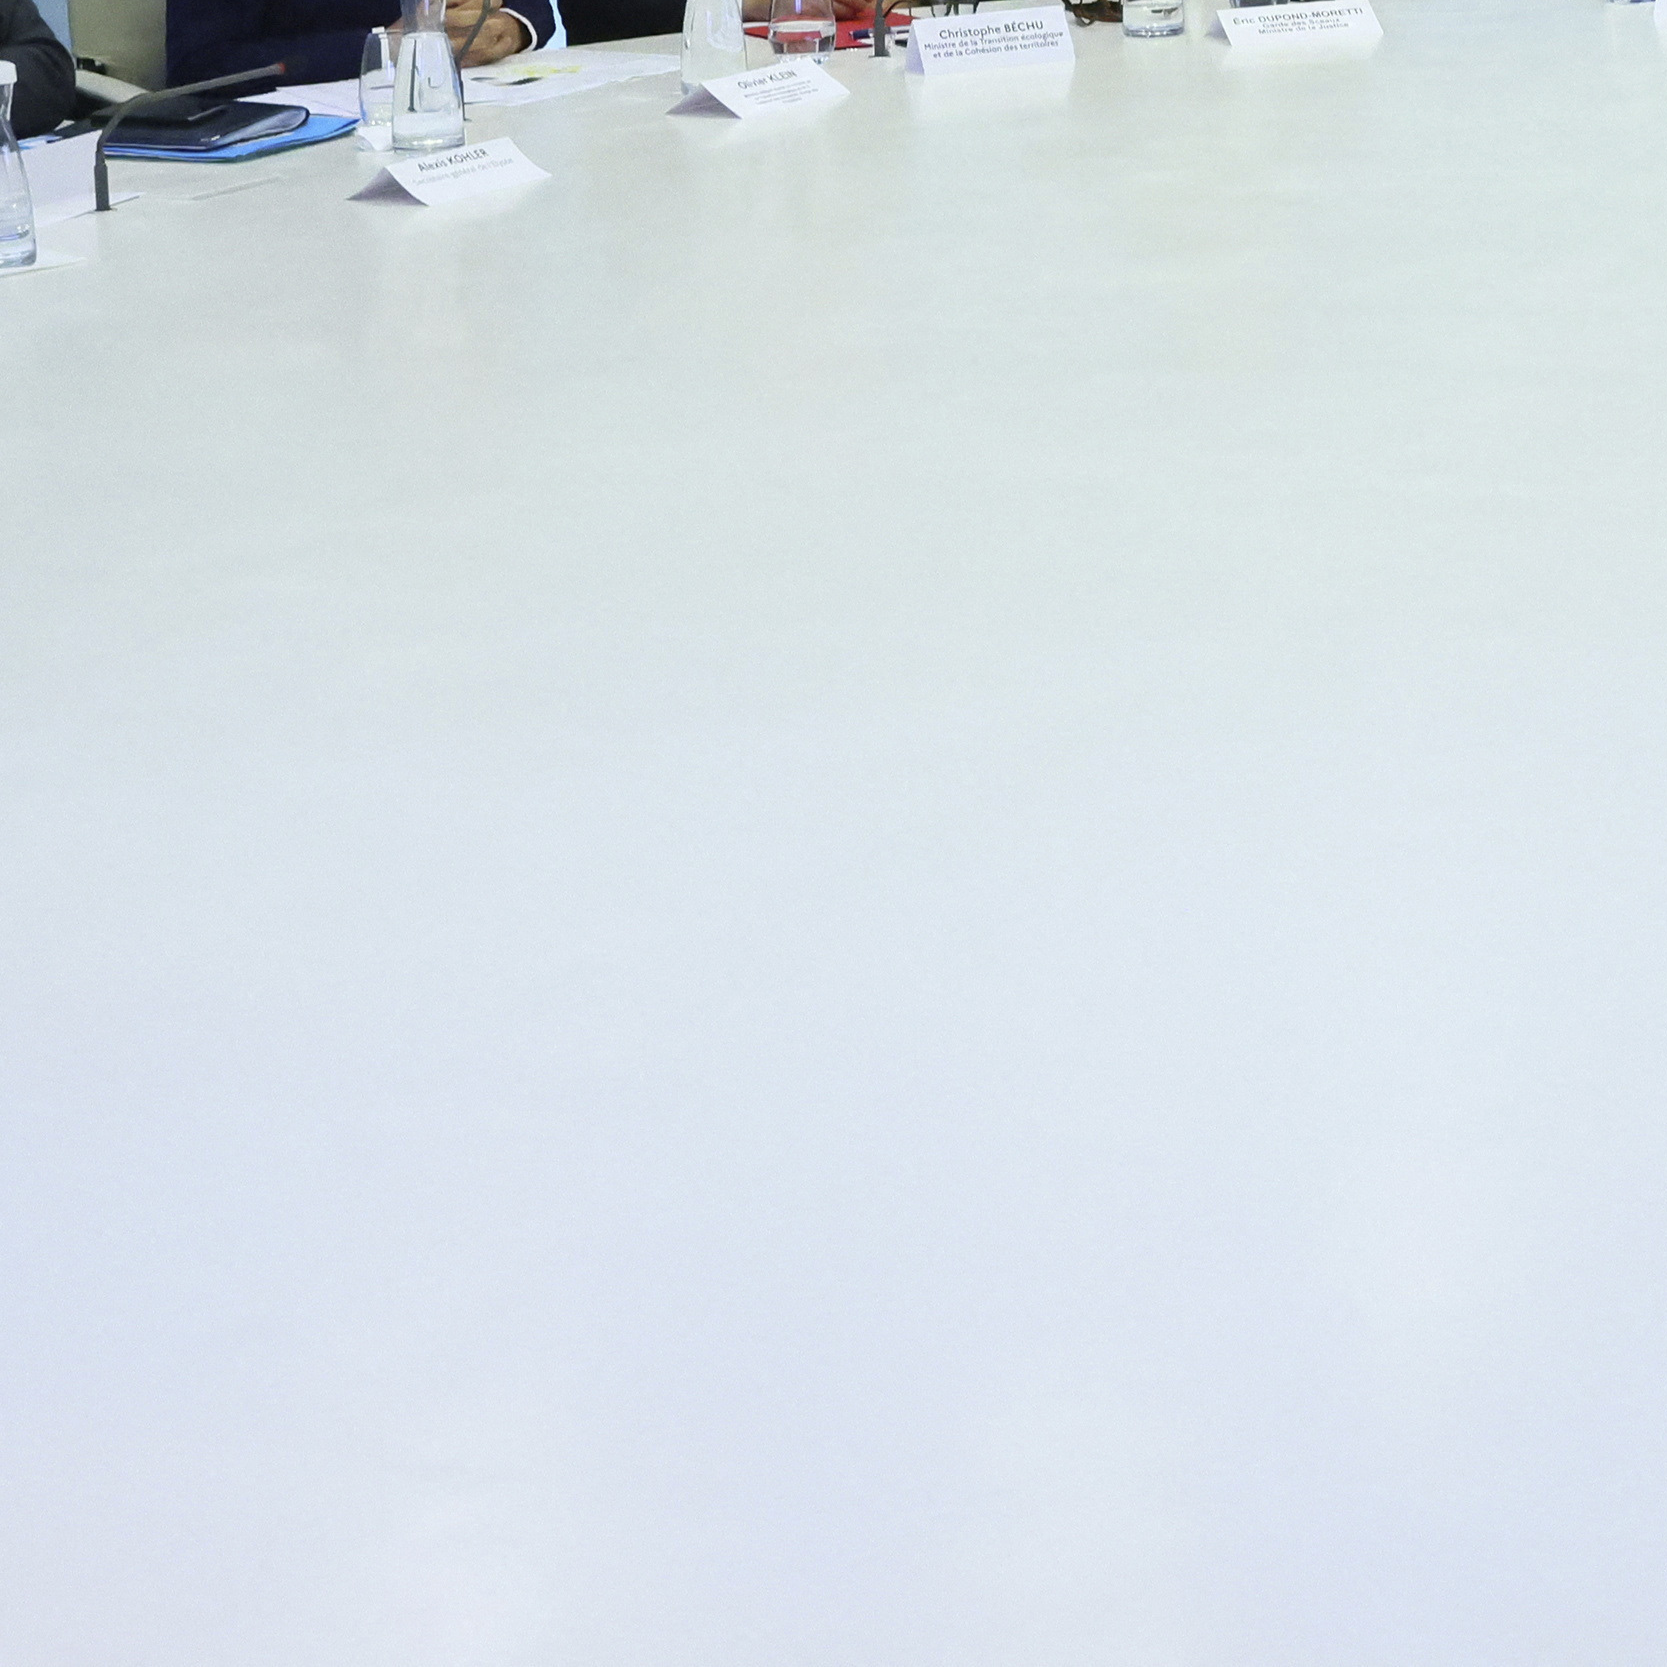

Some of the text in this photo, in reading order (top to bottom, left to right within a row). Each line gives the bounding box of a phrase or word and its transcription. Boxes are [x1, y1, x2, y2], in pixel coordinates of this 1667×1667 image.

[1258, 7, 1363, 23] DUPOND-MORETTI
[939, 20, 1044, 40] Christophe BÉCHU
[1258, 27, 1293, 35] Ministre
[924, 31, 1064, 50] Ministre de la Transition écologique
[933, 40, 1059, 59] et de la Cohésion des territoires
[737, 69, 797, 90] Olivier KLEIN
[417, 148, 489, 172] Alexis KOHLER
